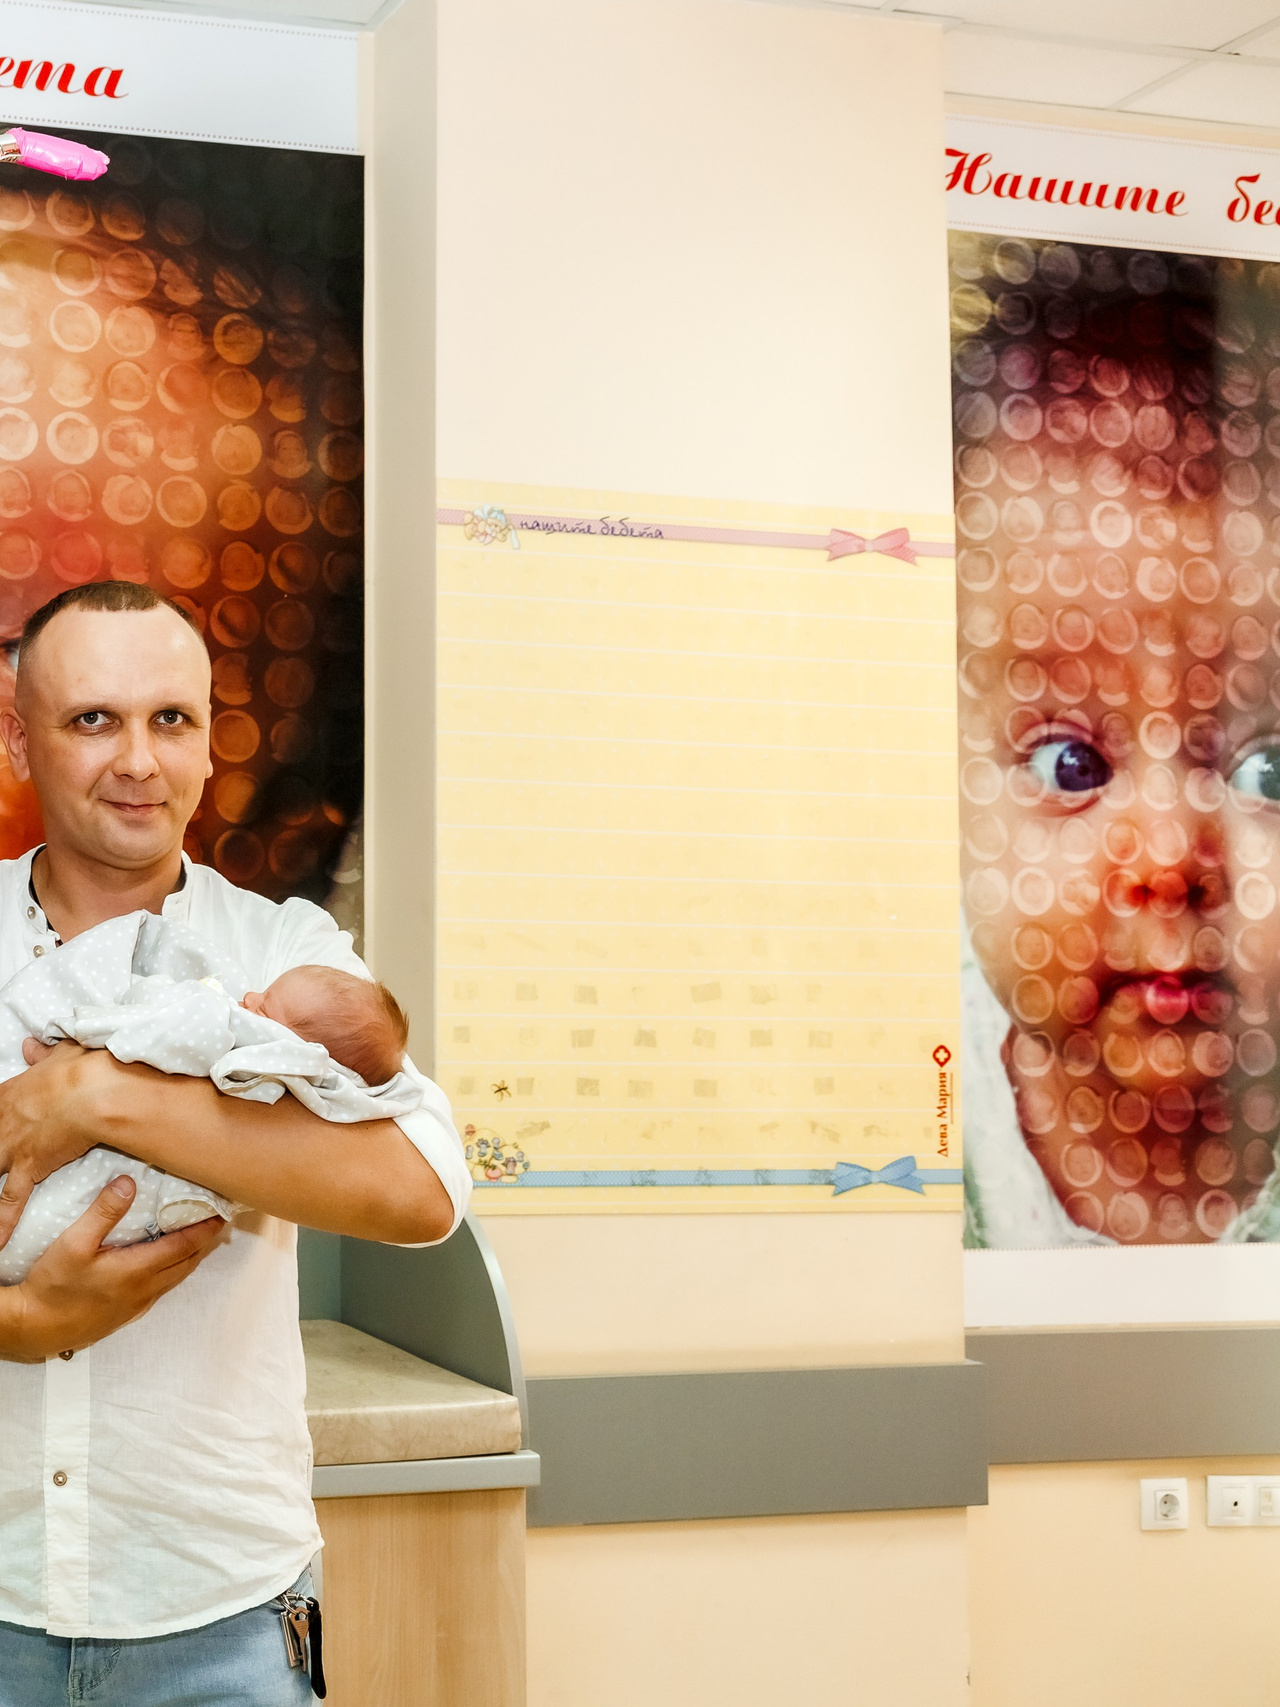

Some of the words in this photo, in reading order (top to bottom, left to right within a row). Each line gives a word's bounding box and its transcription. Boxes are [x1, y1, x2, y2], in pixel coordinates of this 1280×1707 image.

[944, 148, 1189, 217] Нашите
[600, 516, 665, 539] бебета
[936, 1072, 950, 1119] Мария
[937, 1123, 948, 1157] Дева
